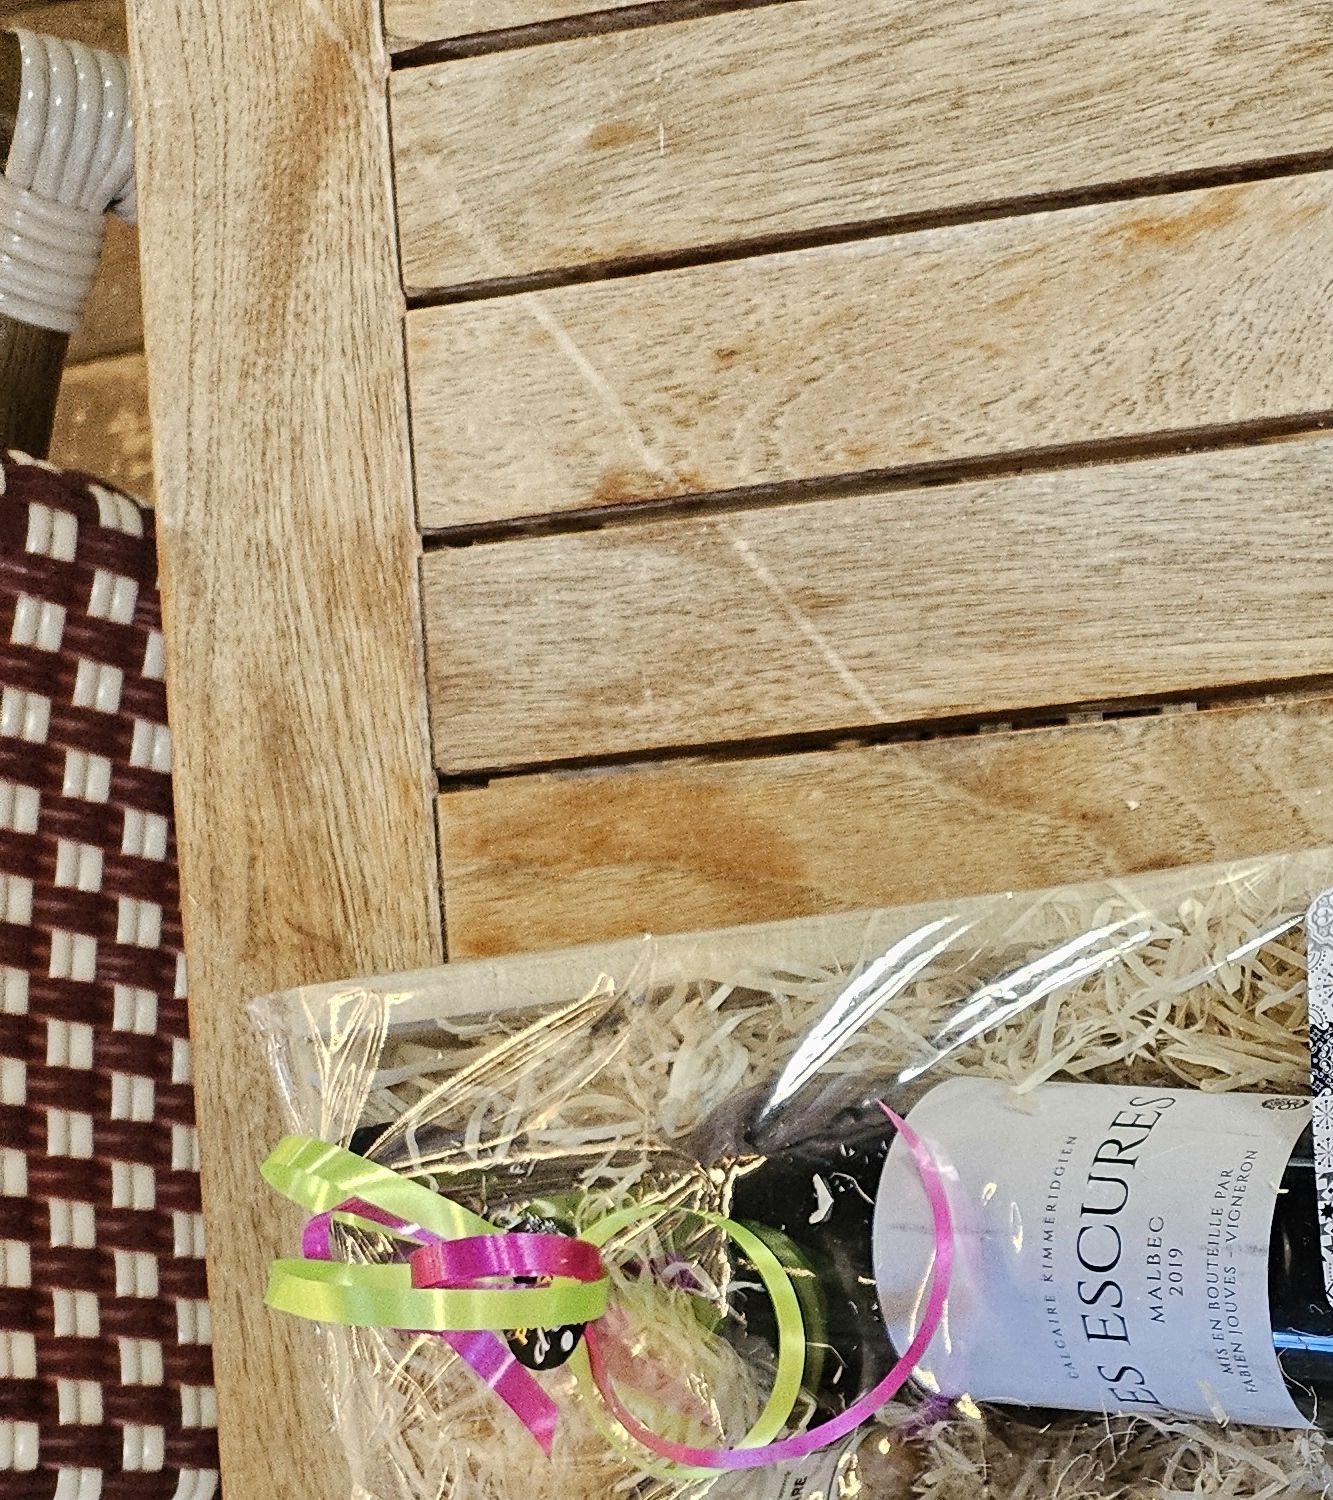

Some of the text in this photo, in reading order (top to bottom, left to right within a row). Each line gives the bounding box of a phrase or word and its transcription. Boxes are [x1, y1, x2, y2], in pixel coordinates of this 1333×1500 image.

[1041, 1134, 1079, 1379] CALCAIRE KIMMERIDGIEN
[1076, 1096, 1177, 1346] ESCURES
[1147, 1215, 1166, 1323] MALBEC
[1168, 1246, 1183, 1296] 2019
[1206, 1169, 1234, 1375] MIS EN BOUTEILLE PAR
[1224, 1149, 1259, 1394] FABIEN JOUVES VIGNERON
